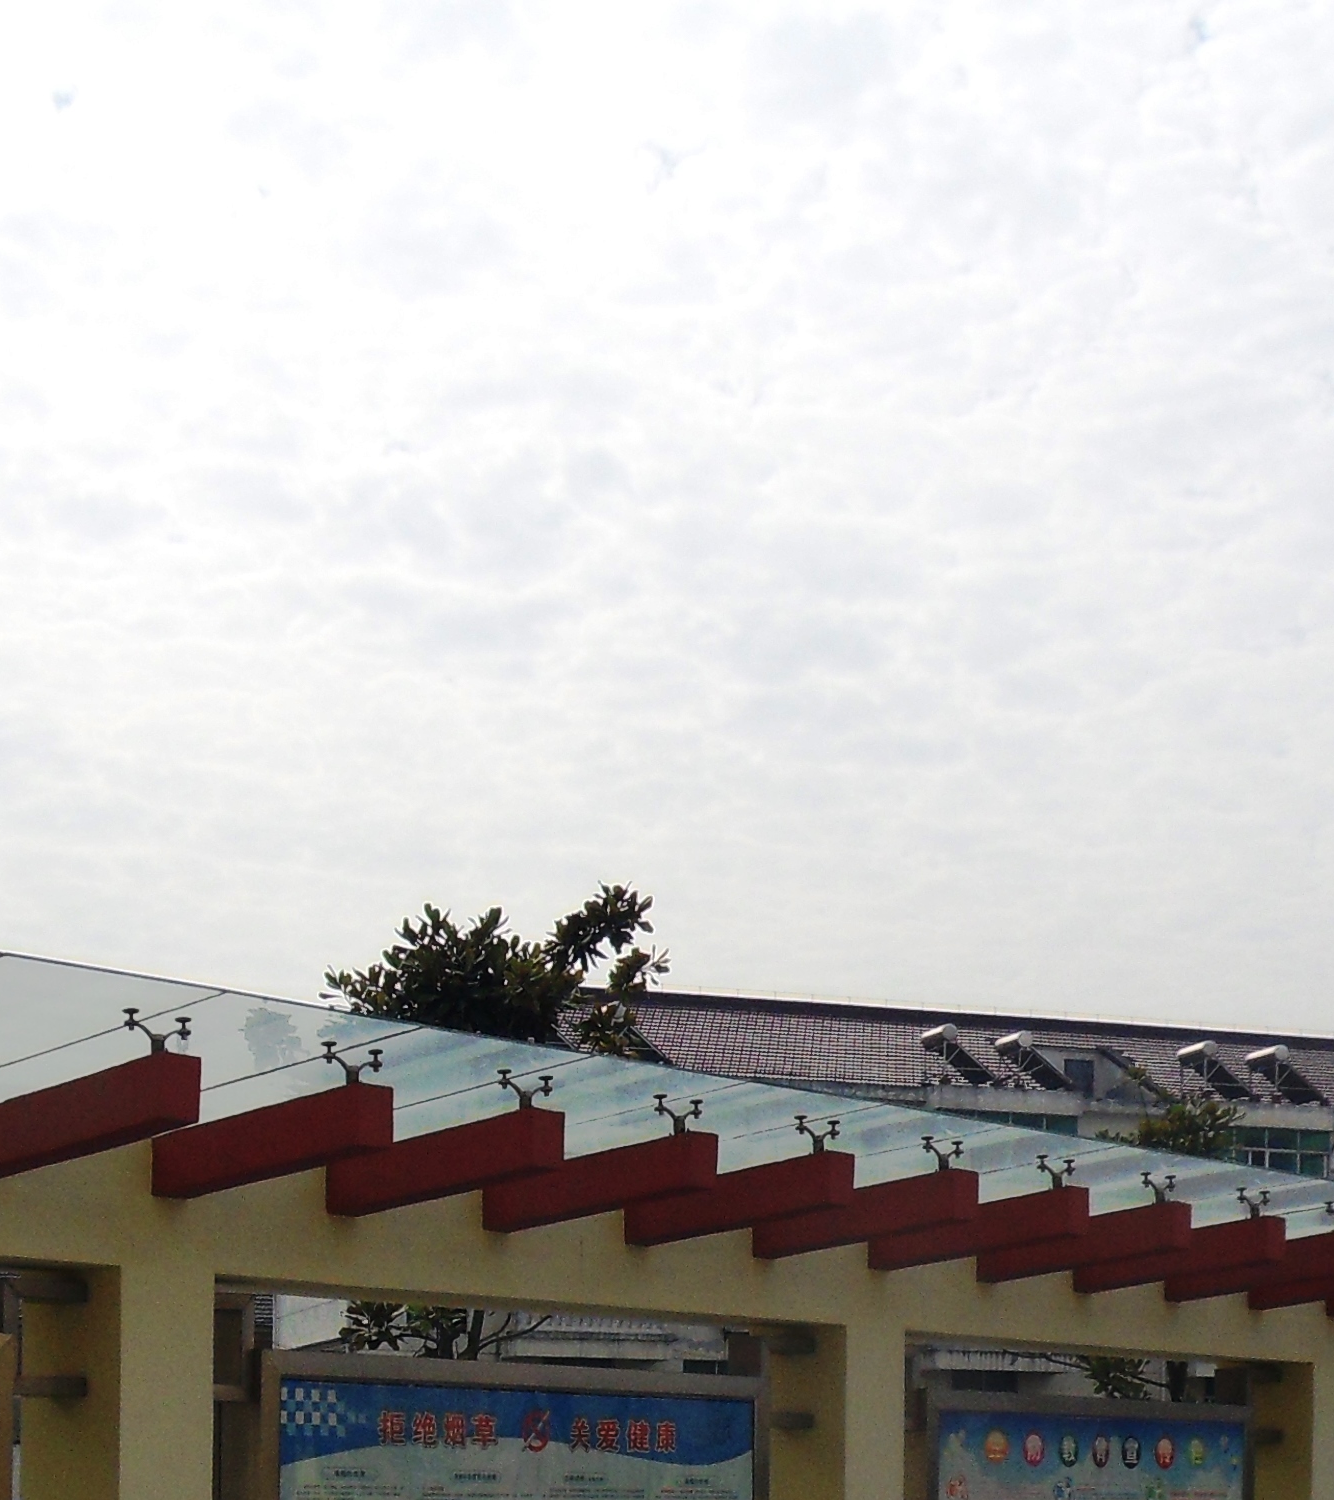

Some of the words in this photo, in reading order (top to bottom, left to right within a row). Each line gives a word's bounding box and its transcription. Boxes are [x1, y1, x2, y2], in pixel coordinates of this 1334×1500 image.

[378, 1409, 499, 1449] 拒绝烟草
[569, 1416, 678, 1454] 关爱健康
